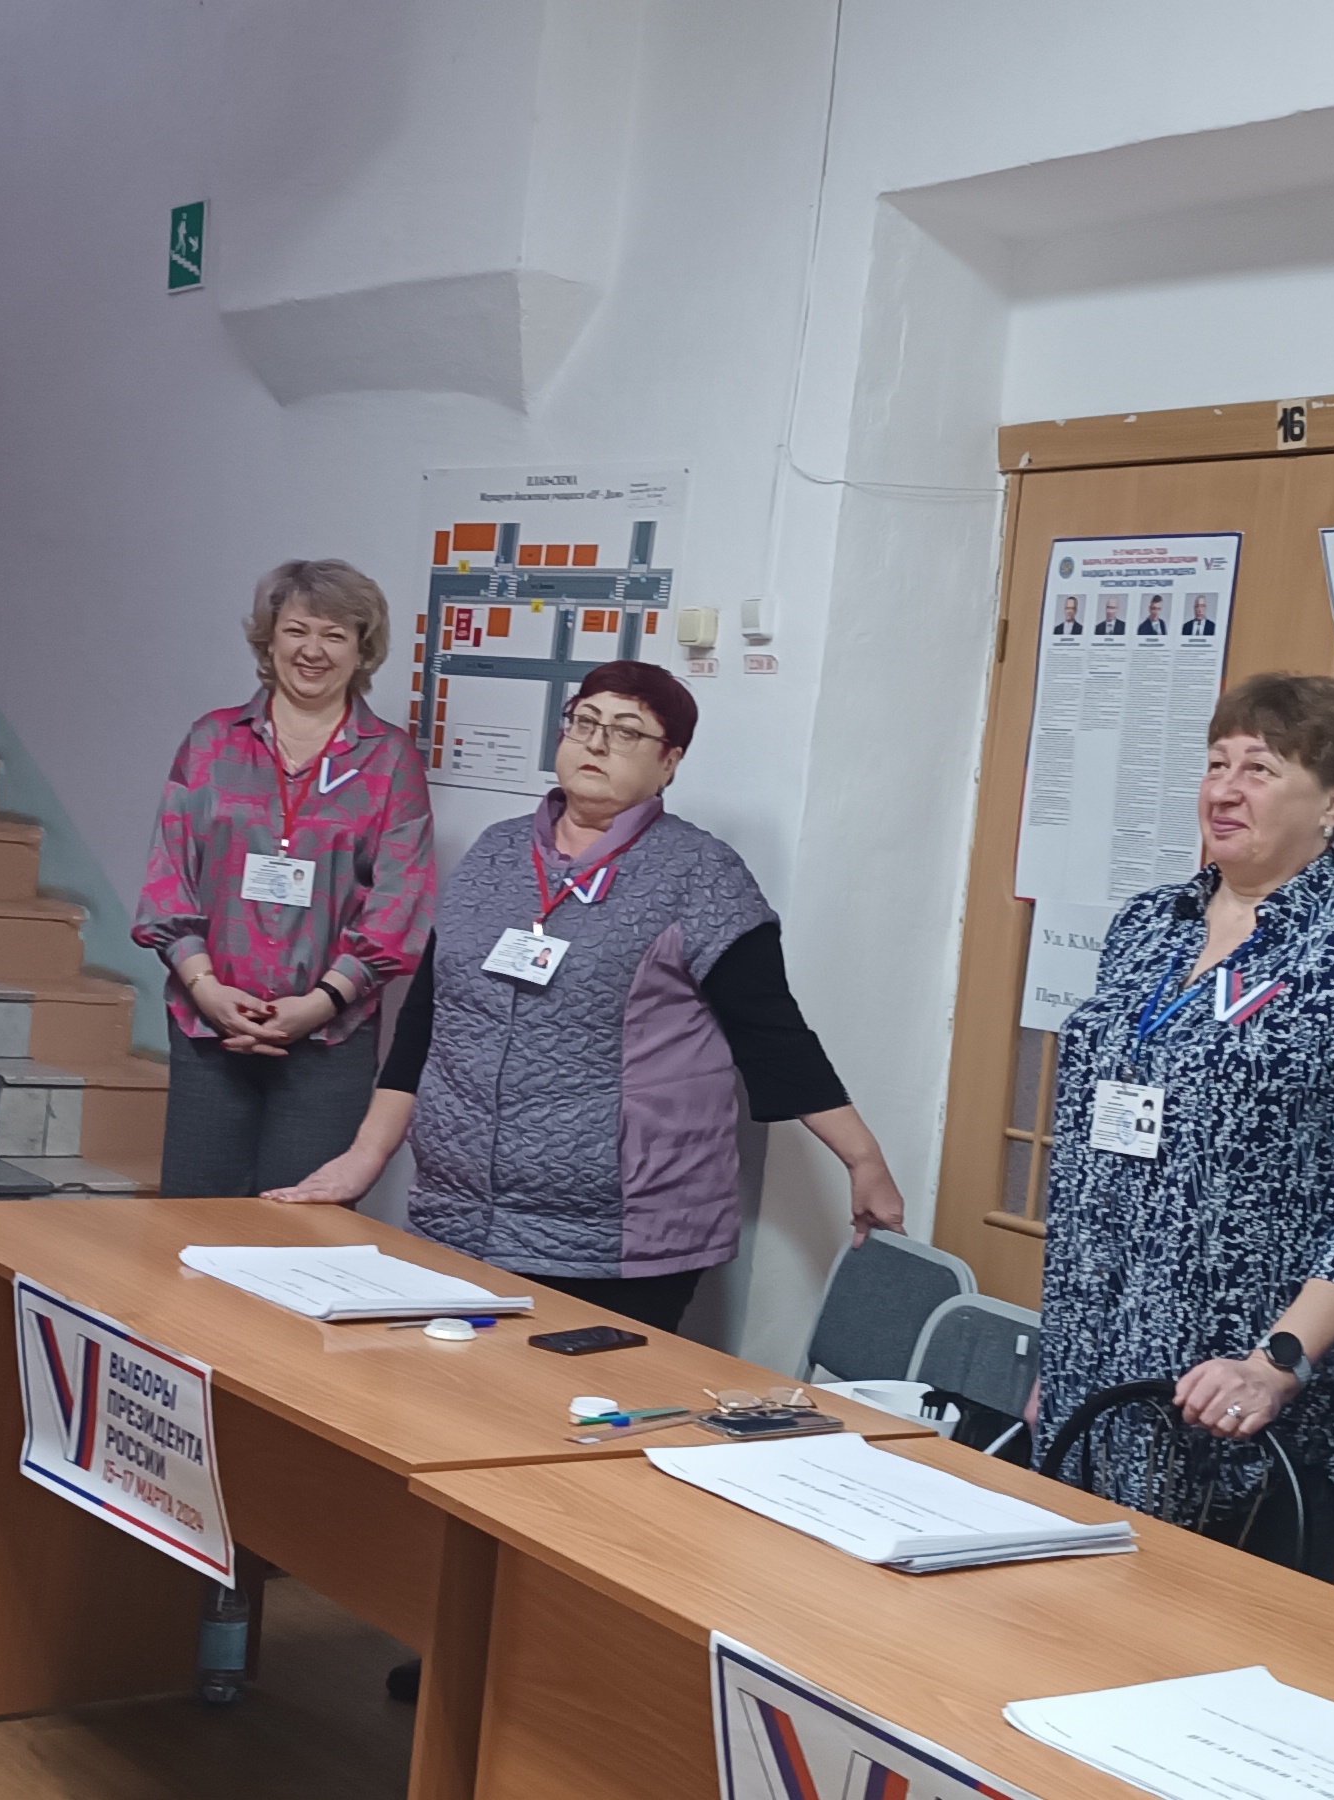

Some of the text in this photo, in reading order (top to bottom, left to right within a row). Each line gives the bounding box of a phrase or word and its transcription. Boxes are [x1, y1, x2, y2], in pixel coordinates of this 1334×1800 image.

[1277, 406, 1305, 443] 16
[109, 1351, 178, 1411] ВЫБОРЫ
[105, 1424, 166, 1480] РОССИИ
[107, 1388, 204, 1466] ПРЕЗИДЕНТА
